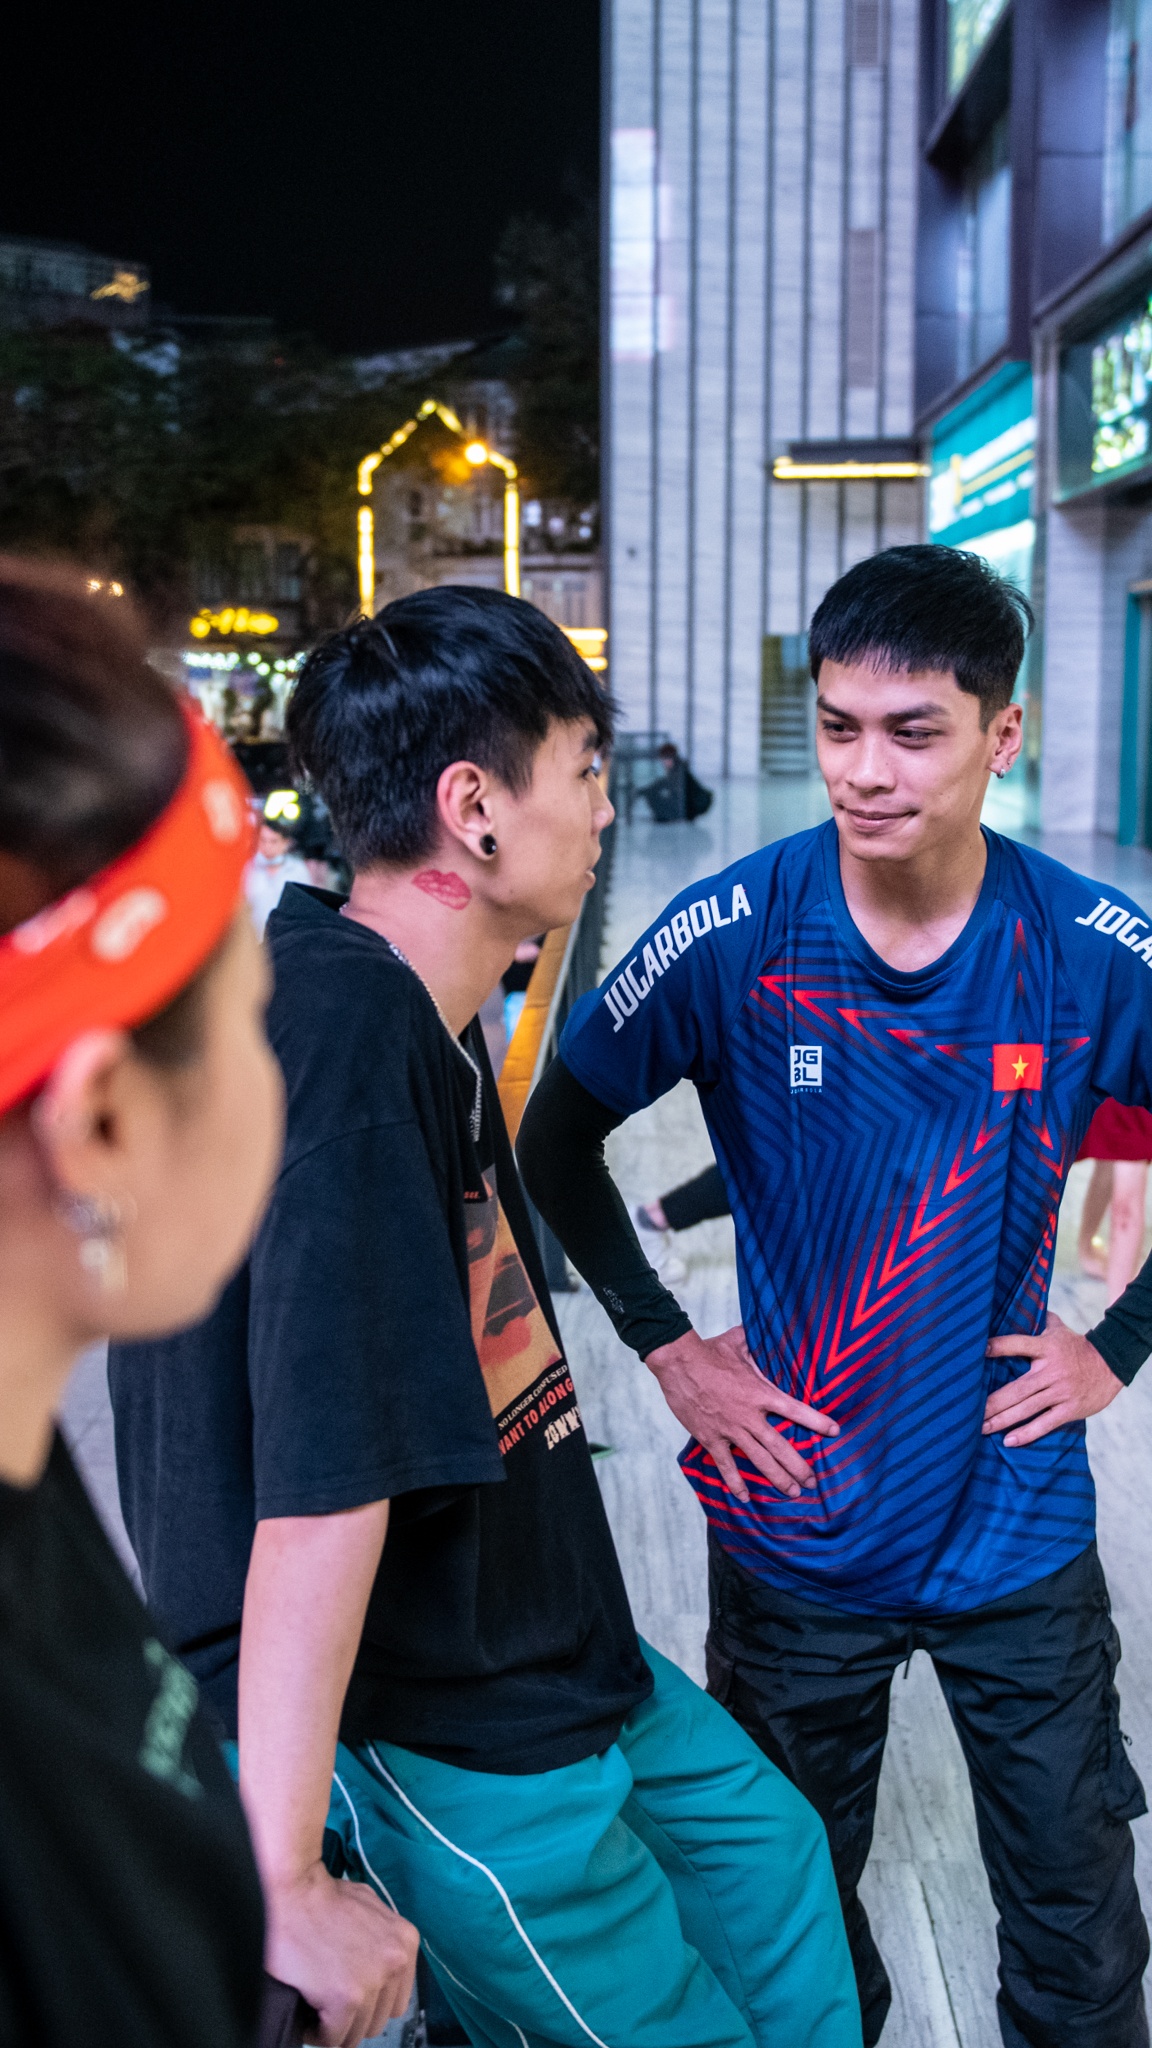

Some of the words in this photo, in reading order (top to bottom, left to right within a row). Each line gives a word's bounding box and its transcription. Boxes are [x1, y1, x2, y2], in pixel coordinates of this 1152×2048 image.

[602, 883, 752, 1033] JOGARBOLA
[1075, 897, 1152, 969] JOGA
[498, 1417, 509, 1430] NO
[507, 1393, 535, 1421] LONGER
[532, 1364, 568, 1397] CONFUSED
[523, 1409, 539, 1429] TO
